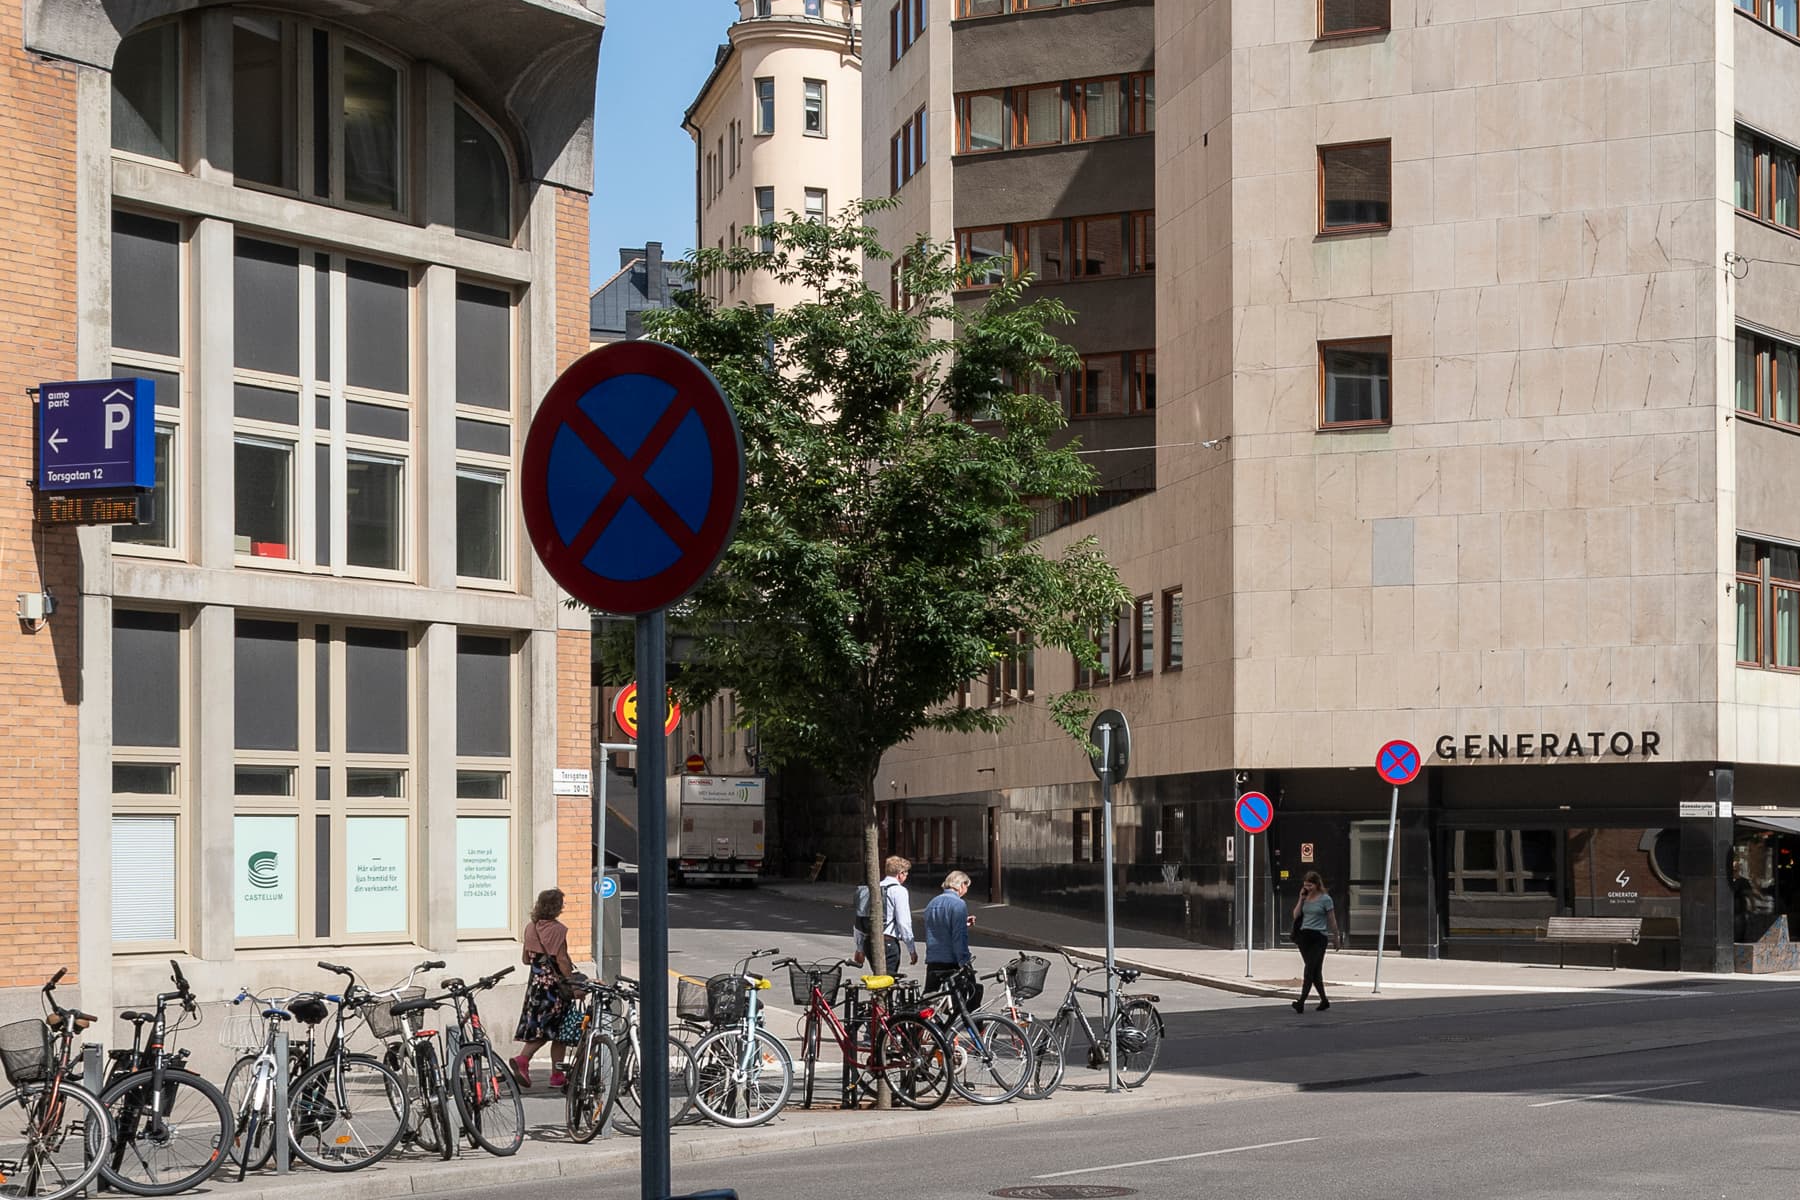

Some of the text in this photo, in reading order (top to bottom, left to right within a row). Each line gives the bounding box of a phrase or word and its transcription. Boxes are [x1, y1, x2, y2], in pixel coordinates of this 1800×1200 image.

[48, 392, 70, 400] aimo
[48, 399, 70, 410] park
[105, 403, 130, 449] P
[48, 469, 103, 483] Torsgatan 12
[1435, 731, 1661, 760] GENERATOR
[357, 864, 368, 872] Här
[369, 864, 387, 872] väntar
[244, 893, 283, 901] CASTELLUM
